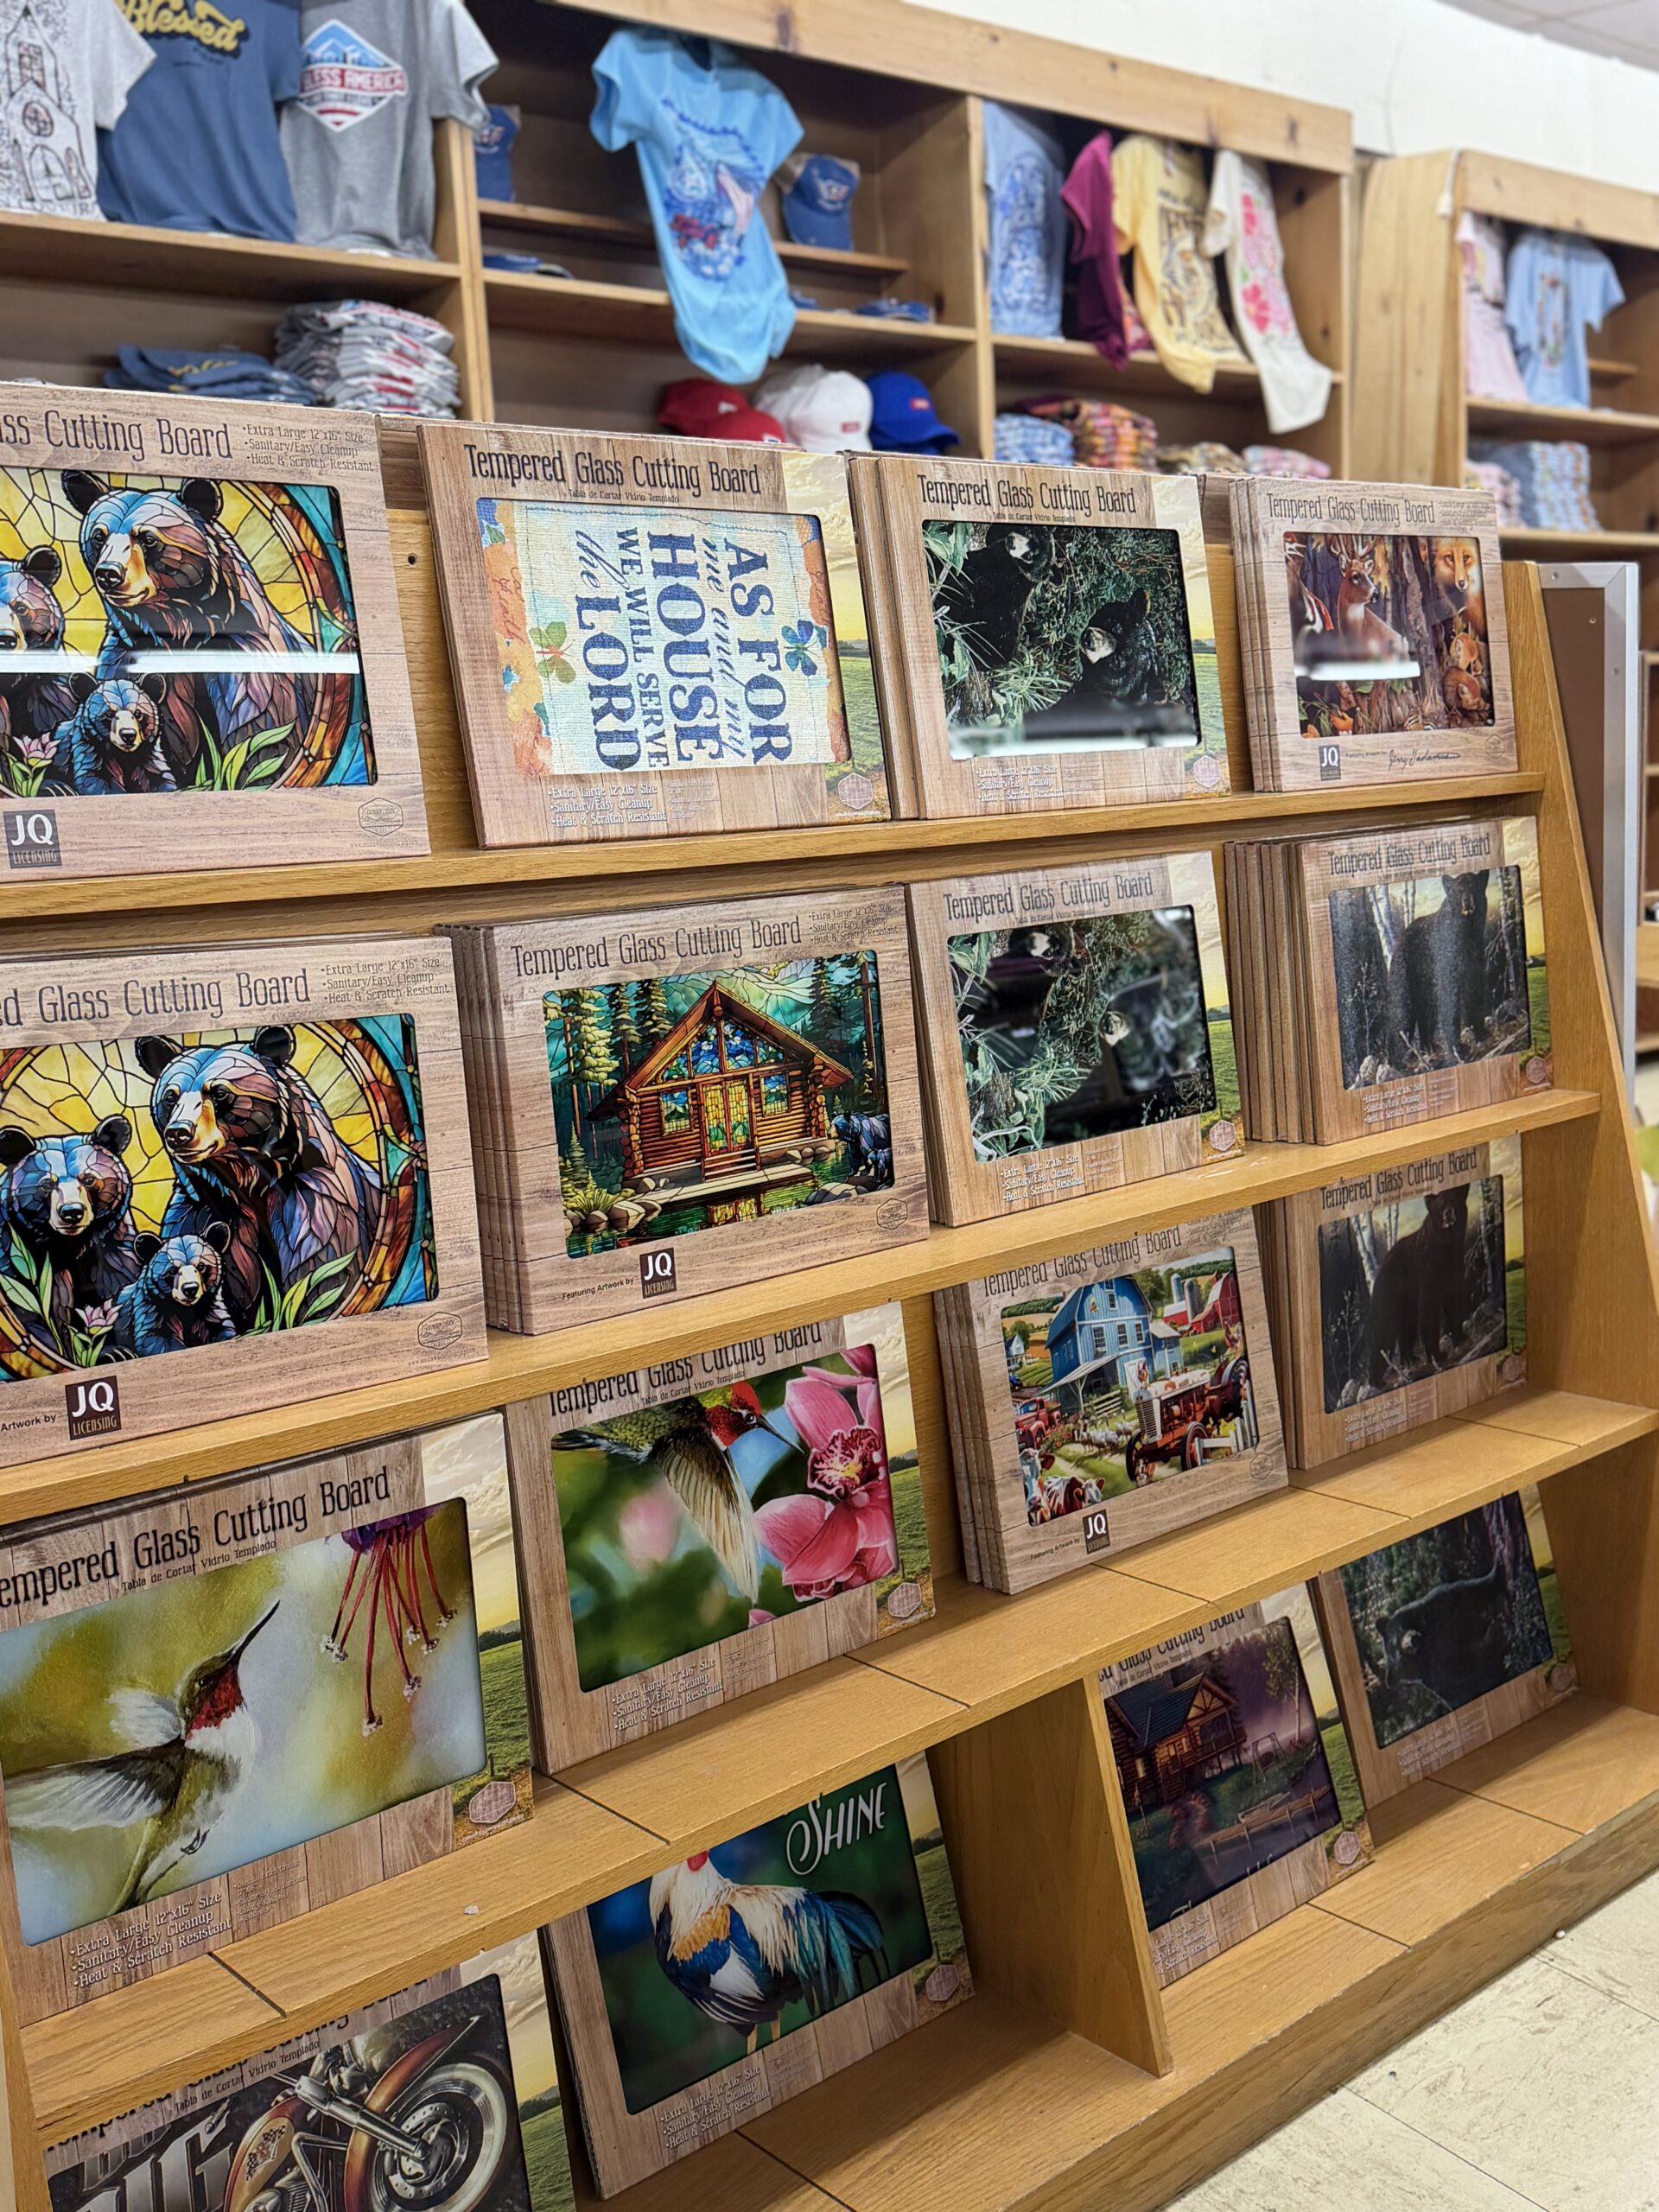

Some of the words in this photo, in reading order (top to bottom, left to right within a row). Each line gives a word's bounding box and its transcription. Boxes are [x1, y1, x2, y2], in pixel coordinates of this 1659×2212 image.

[45, 410, 144, 461] Cutting
[157, 418, 232, 459] Board
[247, 424, 273, 435] Extra
[278, 427, 306, 440] Large
[346, 432, 363, 442] Size
[250, 439, 315, 454] Sanitary/Easy
[321, 444, 358, 458] Cleanup
[251, 454, 273, 465] Heat
[278, 455, 284, 466] &
[289, 456, 326, 468] Scratch
[331, 459, 375, 471] Resistant
[464, 444, 566, 487] Tempered
[575, 452, 624, 486] Glass
[632, 456, 700, 497] Cutting
[709, 461, 761, 494] Board
[918, 475, 991, 511] Tempered
[998, 480, 1033, 508] Glass
[1040, 483, 1091, 517] Cutting
[1096, 486, 1136, 512] Board
[1267, 493, 1322, 524] Tempered
[1328, 497, 1355, 521] Glass
[1361, 499, 1400, 527] Cutting
[1405, 500, 1435, 523] Board
[575, 531, 630, 589] the
[617, 527, 643, 575] WE
[702, 537, 724, 593] me
[725, 537, 775, 617] AS
[626, 587, 654, 662] WILL
[648, 531, 724, 761] HOUSE
[711, 607, 747, 688] and
[575, 594, 641, 771] LORD
[737, 638, 792, 765] FOR
[637, 673, 669, 767] SERVE
[725, 698, 747, 758] my
[1321, 747, 1338, 767] JQ
[552, 788, 576, 798] Extra
[581, 786, 605, 798] Large
[641, 784, 657, 794] Size
[554, 798, 613, 813] Sanitary/Easy
[619, 798, 652, 809] Cleanup
[11, 814, 54, 845] JQ
[556, 816, 576, 827] Heat
[581, 817, 587, 825] &
[591, 812, 623, 825] Scratch
[627, 811, 667, 822] Resistant
[1328, 847, 1382, 877] Tempered
[1387, 843, 1414, 867] Glass
[1418, 837, 1456, 863] Cutting
[1462, 833, 1491, 857] Board
[944, 887, 1014, 924] Tempered
[1020, 885, 1055, 911] Glass
[1061, 878, 1110, 907] Cutting
[1114, 871, 1153, 899] Board
[326, 964, 352, 975] Extra
[357, 963, 383, 974] Large
[422, 958, 440, 967] Size
[511, 937, 609, 980] Tempered
[619, 933, 666, 965] Glass
[675, 925, 741, 957] Cutting
[751, 916, 801, 949] Board
[39, 985, 110, 1024] Glass
[124, 976, 223, 1019] Cutting
[236, 969, 310, 1007] Board
[327, 976, 392, 989] Sanitary/Easy
[397, 972, 434, 984] Cleanup
[328, 993, 353, 1003] Heat
[355, 992, 361, 1001] &
[367, 988, 402, 1000] Scratch
[407, 984, 449, 996] Resistant
[1320, 1175, 1371, 1210] Tempered
[1377, 1170, 1402, 1194] Glass
[1408, 1158, 1444, 1185] Cutting
[1449, 1147, 1477, 1175] Board
[644, 1252, 672, 1281] JQ
[1054, 1251, 1087, 1278] Glass
[563, 1287, 594, 1300] Featuring
[598, 1281, 624, 1291] Artwork
[648, 1356, 693, 1389] Glass
[72, 1382, 114, 1417] JQ
[1, 1417, 41, 1432] Artwork
[44, 1414, 56, 1423] by
[73, 1415, 117, 1435] LICENSING
[0, 1542, 119, 1606] empered
[134, 1523, 200, 1569] Glass
[213, 1497, 306, 1546] Cutting
[320, 1466, 390, 1516] Board
[1087, 1514, 1106, 1539] JQ
[122, 1576, 147, 1592] Tabla
[151, 1573, 162, 1583] de
[166, 1563, 196, 1579] Cortar
[201, 1552, 230, 1568] Vidrio
[234, 1539, 276, 1559] Templado
[615, 1692, 639, 1704] Extra
[643, 1679, 665, 1694] Large
[700, 1660, 715, 1670] Size
[617, 1689, 673, 1718] Sanitary/Easy
[678, 1673, 710, 1693] Cleanup
[619, 1718, 638, 1731] Heat
[652, 1700, 683, 1717] Scratch
[686, 1681, 722, 1703] Resistant
[76, 1937, 110, 1957] Extra
[116, 1920, 149, 1942] Large
[156, 1902, 193, 1926] 12"x16"
[200, 1892, 221, 1908] Size
[78, 1931, 161, 1973] Sanitary/Easy
[168, 1910, 213, 1936] Cleanup
[79, 1970, 108, 1988] Heat
[113, 1962, 122, 1974] &
[128, 1942, 173, 1968] Scratch
[179, 1918, 232, 1948] Resistant
[174, 2096, 197, 2113] Tabla
[201, 2091, 213, 2101] de
[248, 2060, 276, 2079] Vidrio
[280, 2042, 320, 2064] Templado
[664, 2107, 687, 2122] Extra
[734, 2088, 770, 2113] Resistant
